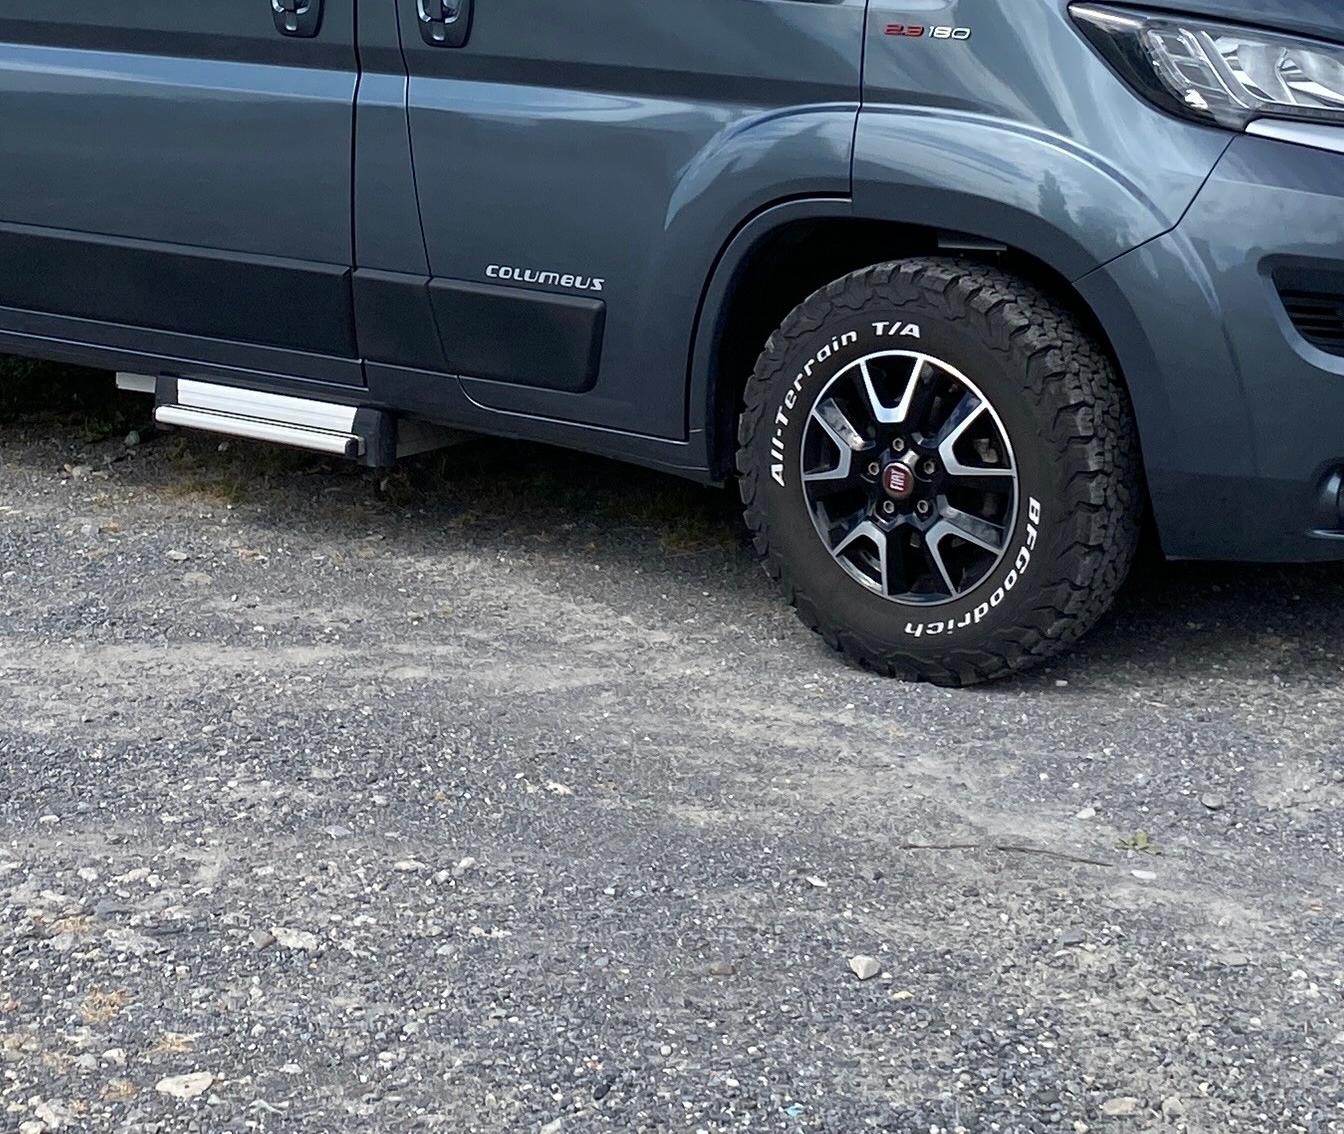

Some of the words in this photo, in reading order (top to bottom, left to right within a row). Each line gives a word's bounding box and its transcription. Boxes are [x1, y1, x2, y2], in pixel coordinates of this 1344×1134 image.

[928, 26, 972, 41] 180
[485, 264, 605, 291] COLUMBUS
[769, 329, 858, 487] All-Terrain
[871, 321, 921, 339] T/A
[904, 496, 1042, 638] BFGoodrich
